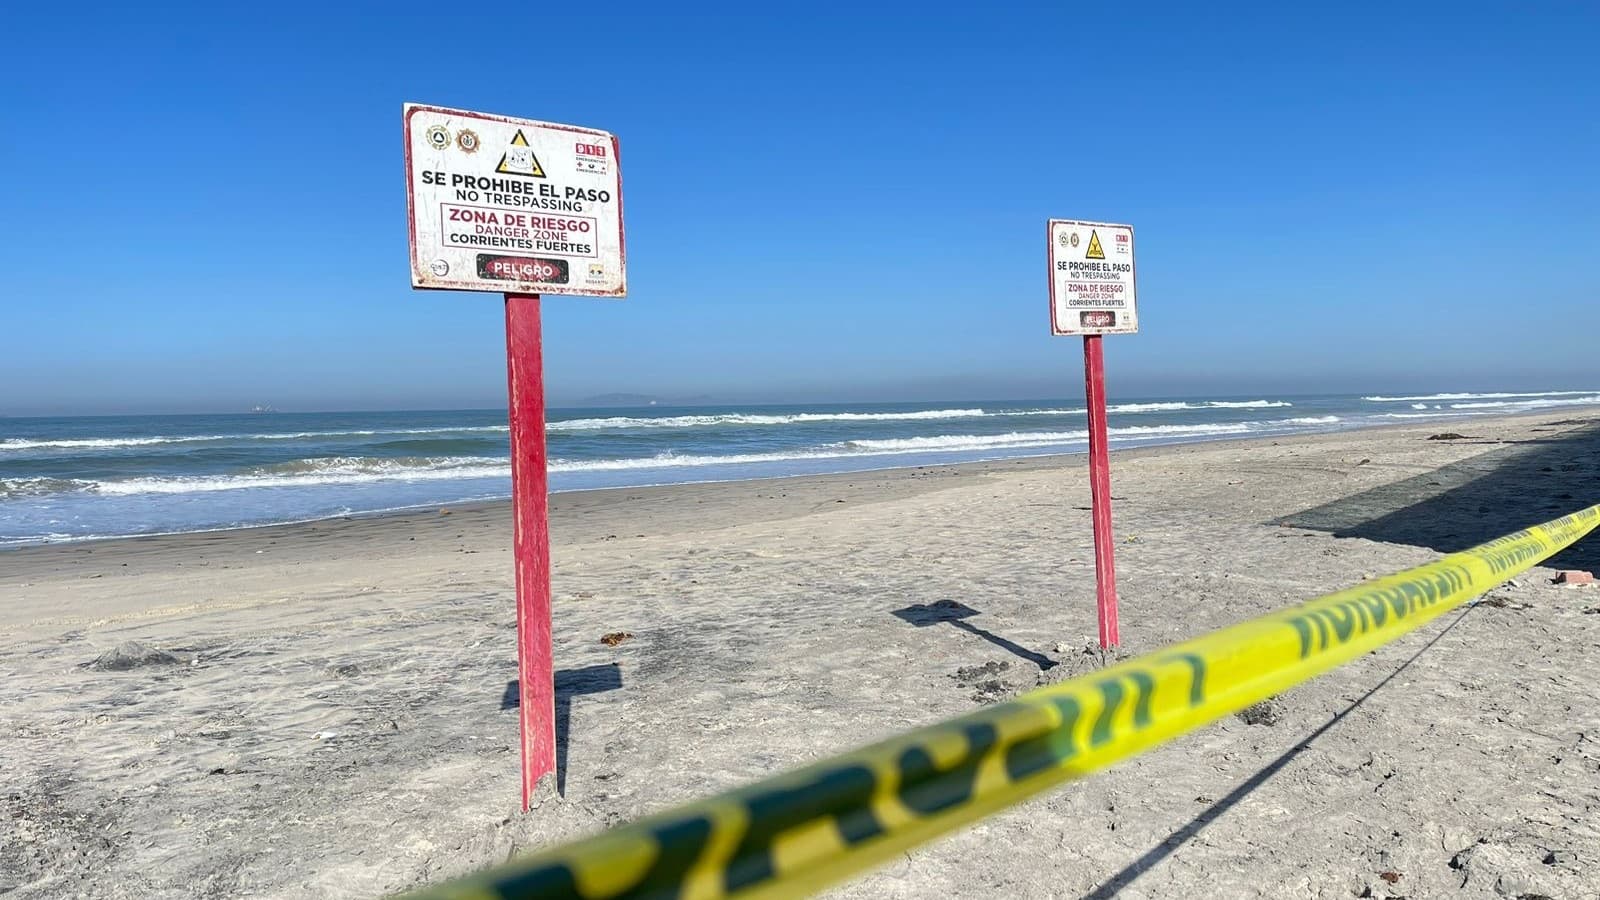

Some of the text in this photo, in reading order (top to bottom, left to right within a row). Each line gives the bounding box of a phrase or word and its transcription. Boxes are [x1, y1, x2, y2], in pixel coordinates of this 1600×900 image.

[422, 170, 610, 204] SE PROHIBE EL PASO
[456, 189, 583, 213] NO TRESPASSING
[449, 208, 590, 233] ZONA DE RIESGO
[475, 224, 568, 242] DANGER ZONE
[450, 233, 591, 254] CORRIENTES FUERTES
[494, 262, 553, 277] PELIGRO
[1057, 261, 1131, 273] SE PROHIBE EL PASO
[1082, 272, 1120, 280] TRESPASSING
[1068, 283, 1124, 293] ZONA DE RIESGO
